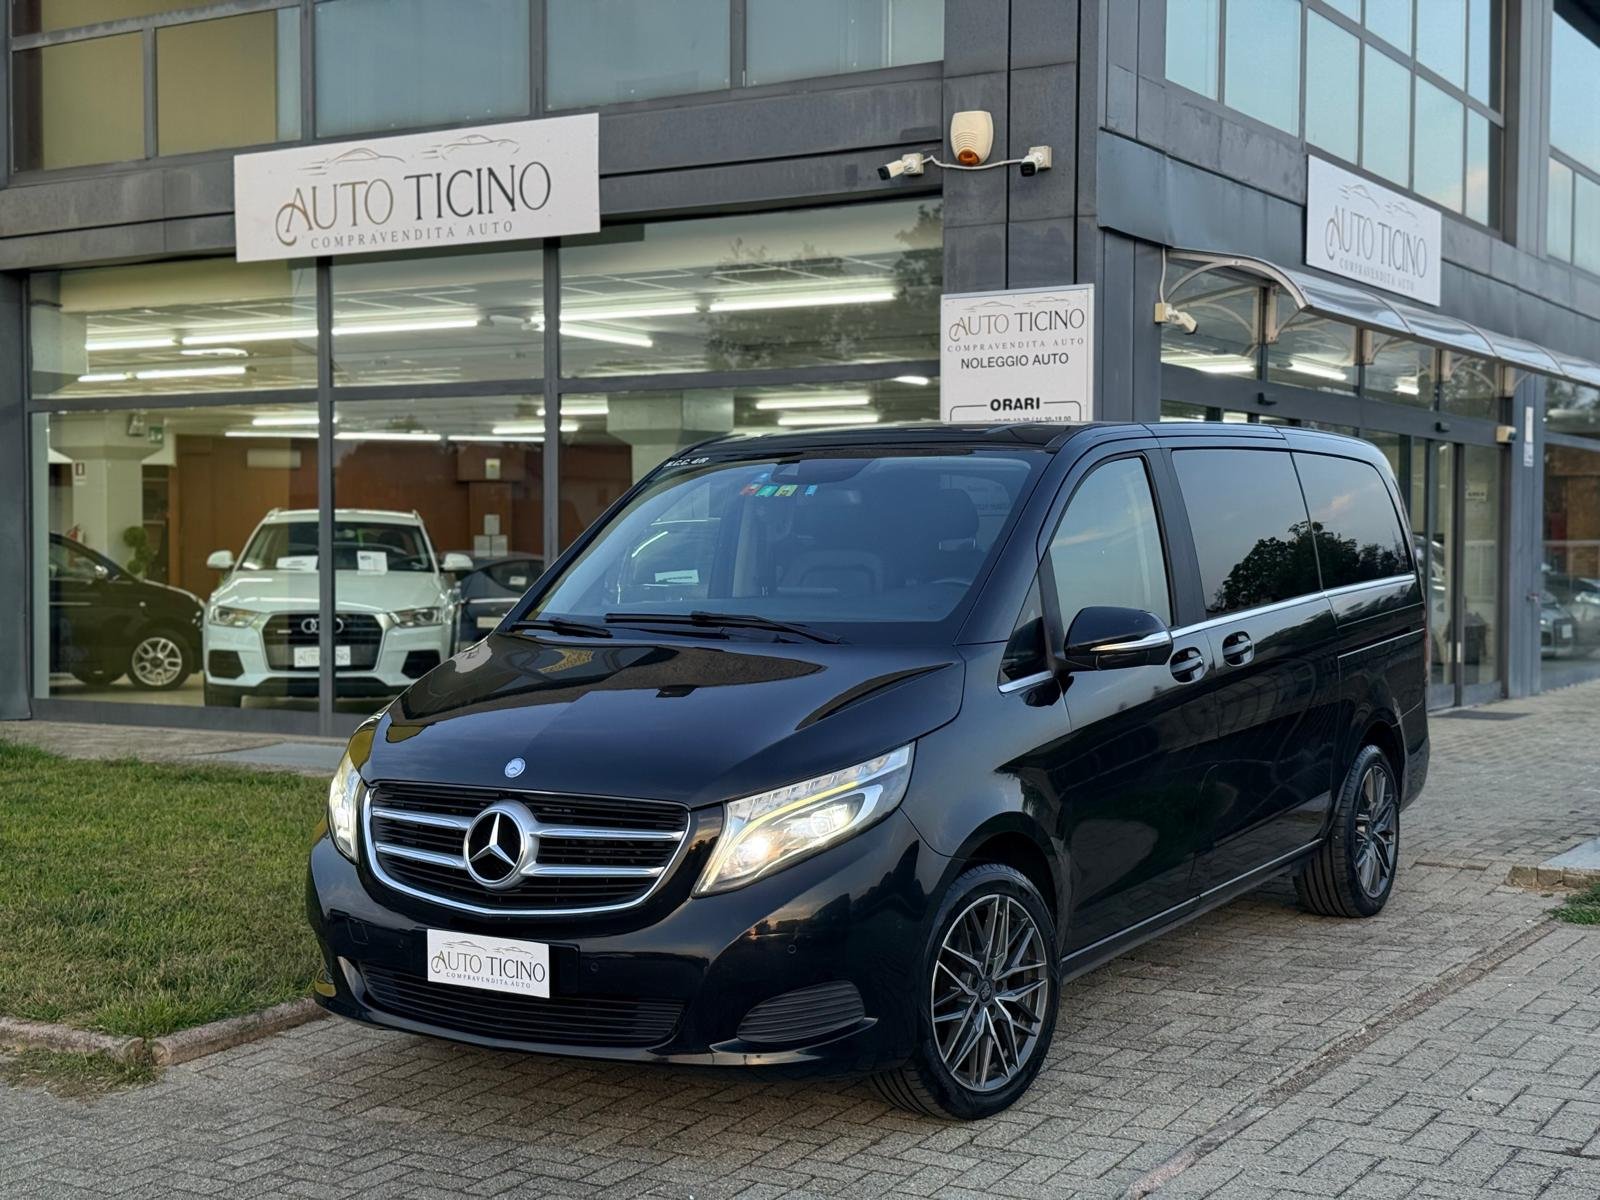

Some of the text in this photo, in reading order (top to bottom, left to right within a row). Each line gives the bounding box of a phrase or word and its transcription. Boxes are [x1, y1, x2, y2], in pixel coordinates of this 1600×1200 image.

[275, 161, 552, 247] AUTO TICINO
[311, 221, 514, 250] COMPRAVENDITA AUTO
[1325, 205, 1427, 278] AUTO TICINO
[949, 308, 1085, 342] AUTO TICINO
[947, 338, 1084, 353] COMPRAVENDITA AUTO
[961, 352, 1069, 369] NOLEGGIO AUTO
[990, 397, 1040, 411] ORARI
[431, 950, 546, 982] AUTO TICINO
[446, 972, 531, 989] COMPRAVENDITA AUTO
